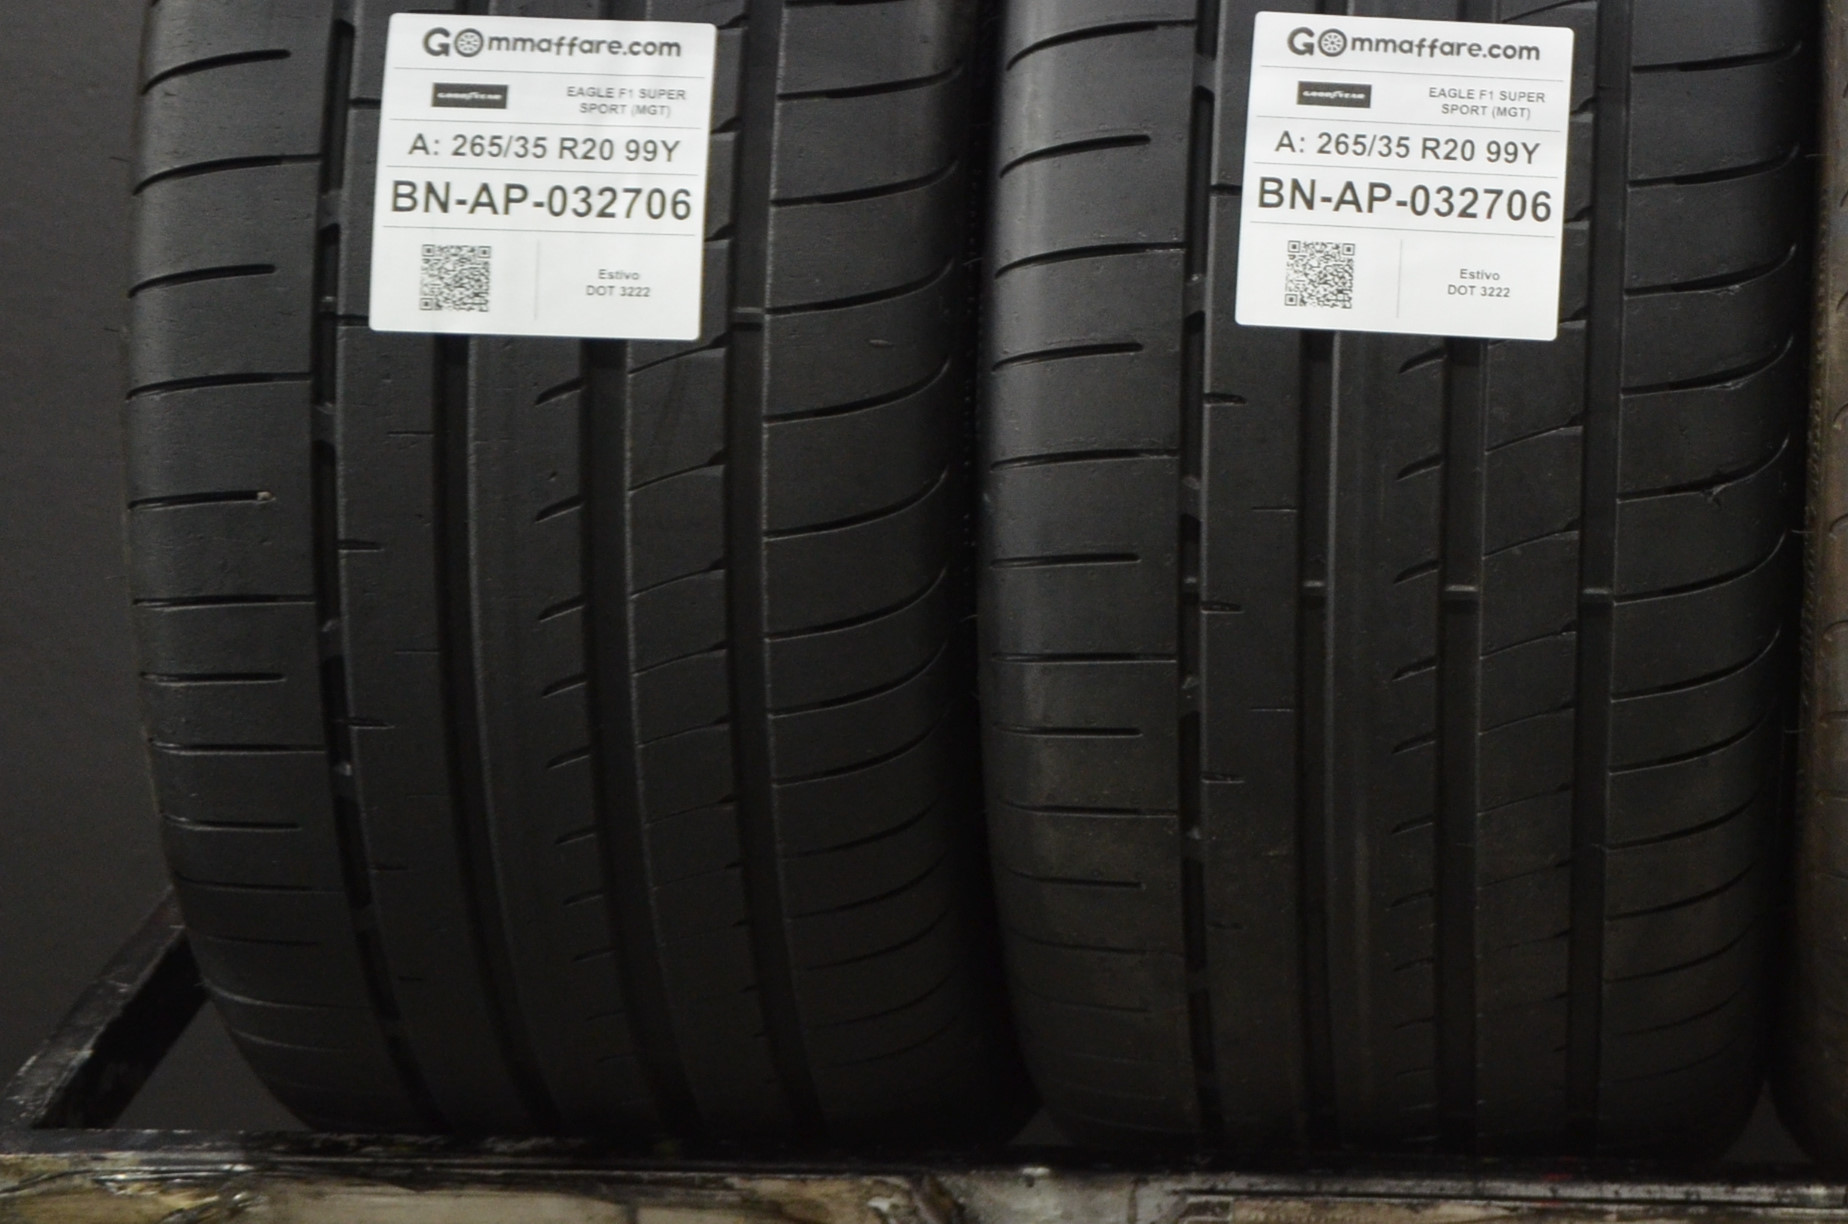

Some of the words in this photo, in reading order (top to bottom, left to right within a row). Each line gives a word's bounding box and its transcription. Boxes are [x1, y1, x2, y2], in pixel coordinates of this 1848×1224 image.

[566, 86, 615, 99] EAGLE
[618, 87, 633, 99] F1
[638, 88, 686, 101] SUPER
[1428, 86, 1475, 100] EAGLE
[1478, 89, 1494, 100] F1
[1499, 90, 1546, 103] SUPER
[579, 102, 627, 115] SPORT
[631, 104, 670, 117] (MGT)
[1441, 103, 1488, 116] SPORT
[1491, 106, 1531, 121] (MGT)
[408, 132, 439, 156] A:
[451, 133, 547, 159] 265/35
[558, 136, 615, 161] R20
[625, 138, 681, 163] 99Y
[1274, 130, 1305, 153] A:
[1316, 131, 1410, 159] 265/35
[1421, 136, 1476, 162] R20
[1486, 140, 1541, 165] 99Y
[391, 179, 691, 221] BN-AP-032706
[1258, 176, 1552, 223] BN-AP-032706
[598, 268, 640, 281] Estivo
[1459, 268, 1501, 281] Estivo
[586, 284, 616, 297] DOT
[619, 286, 651, 298] 3222
[1447, 283, 1477, 296] DOT
[1480, 286, 1511, 298] 3222
